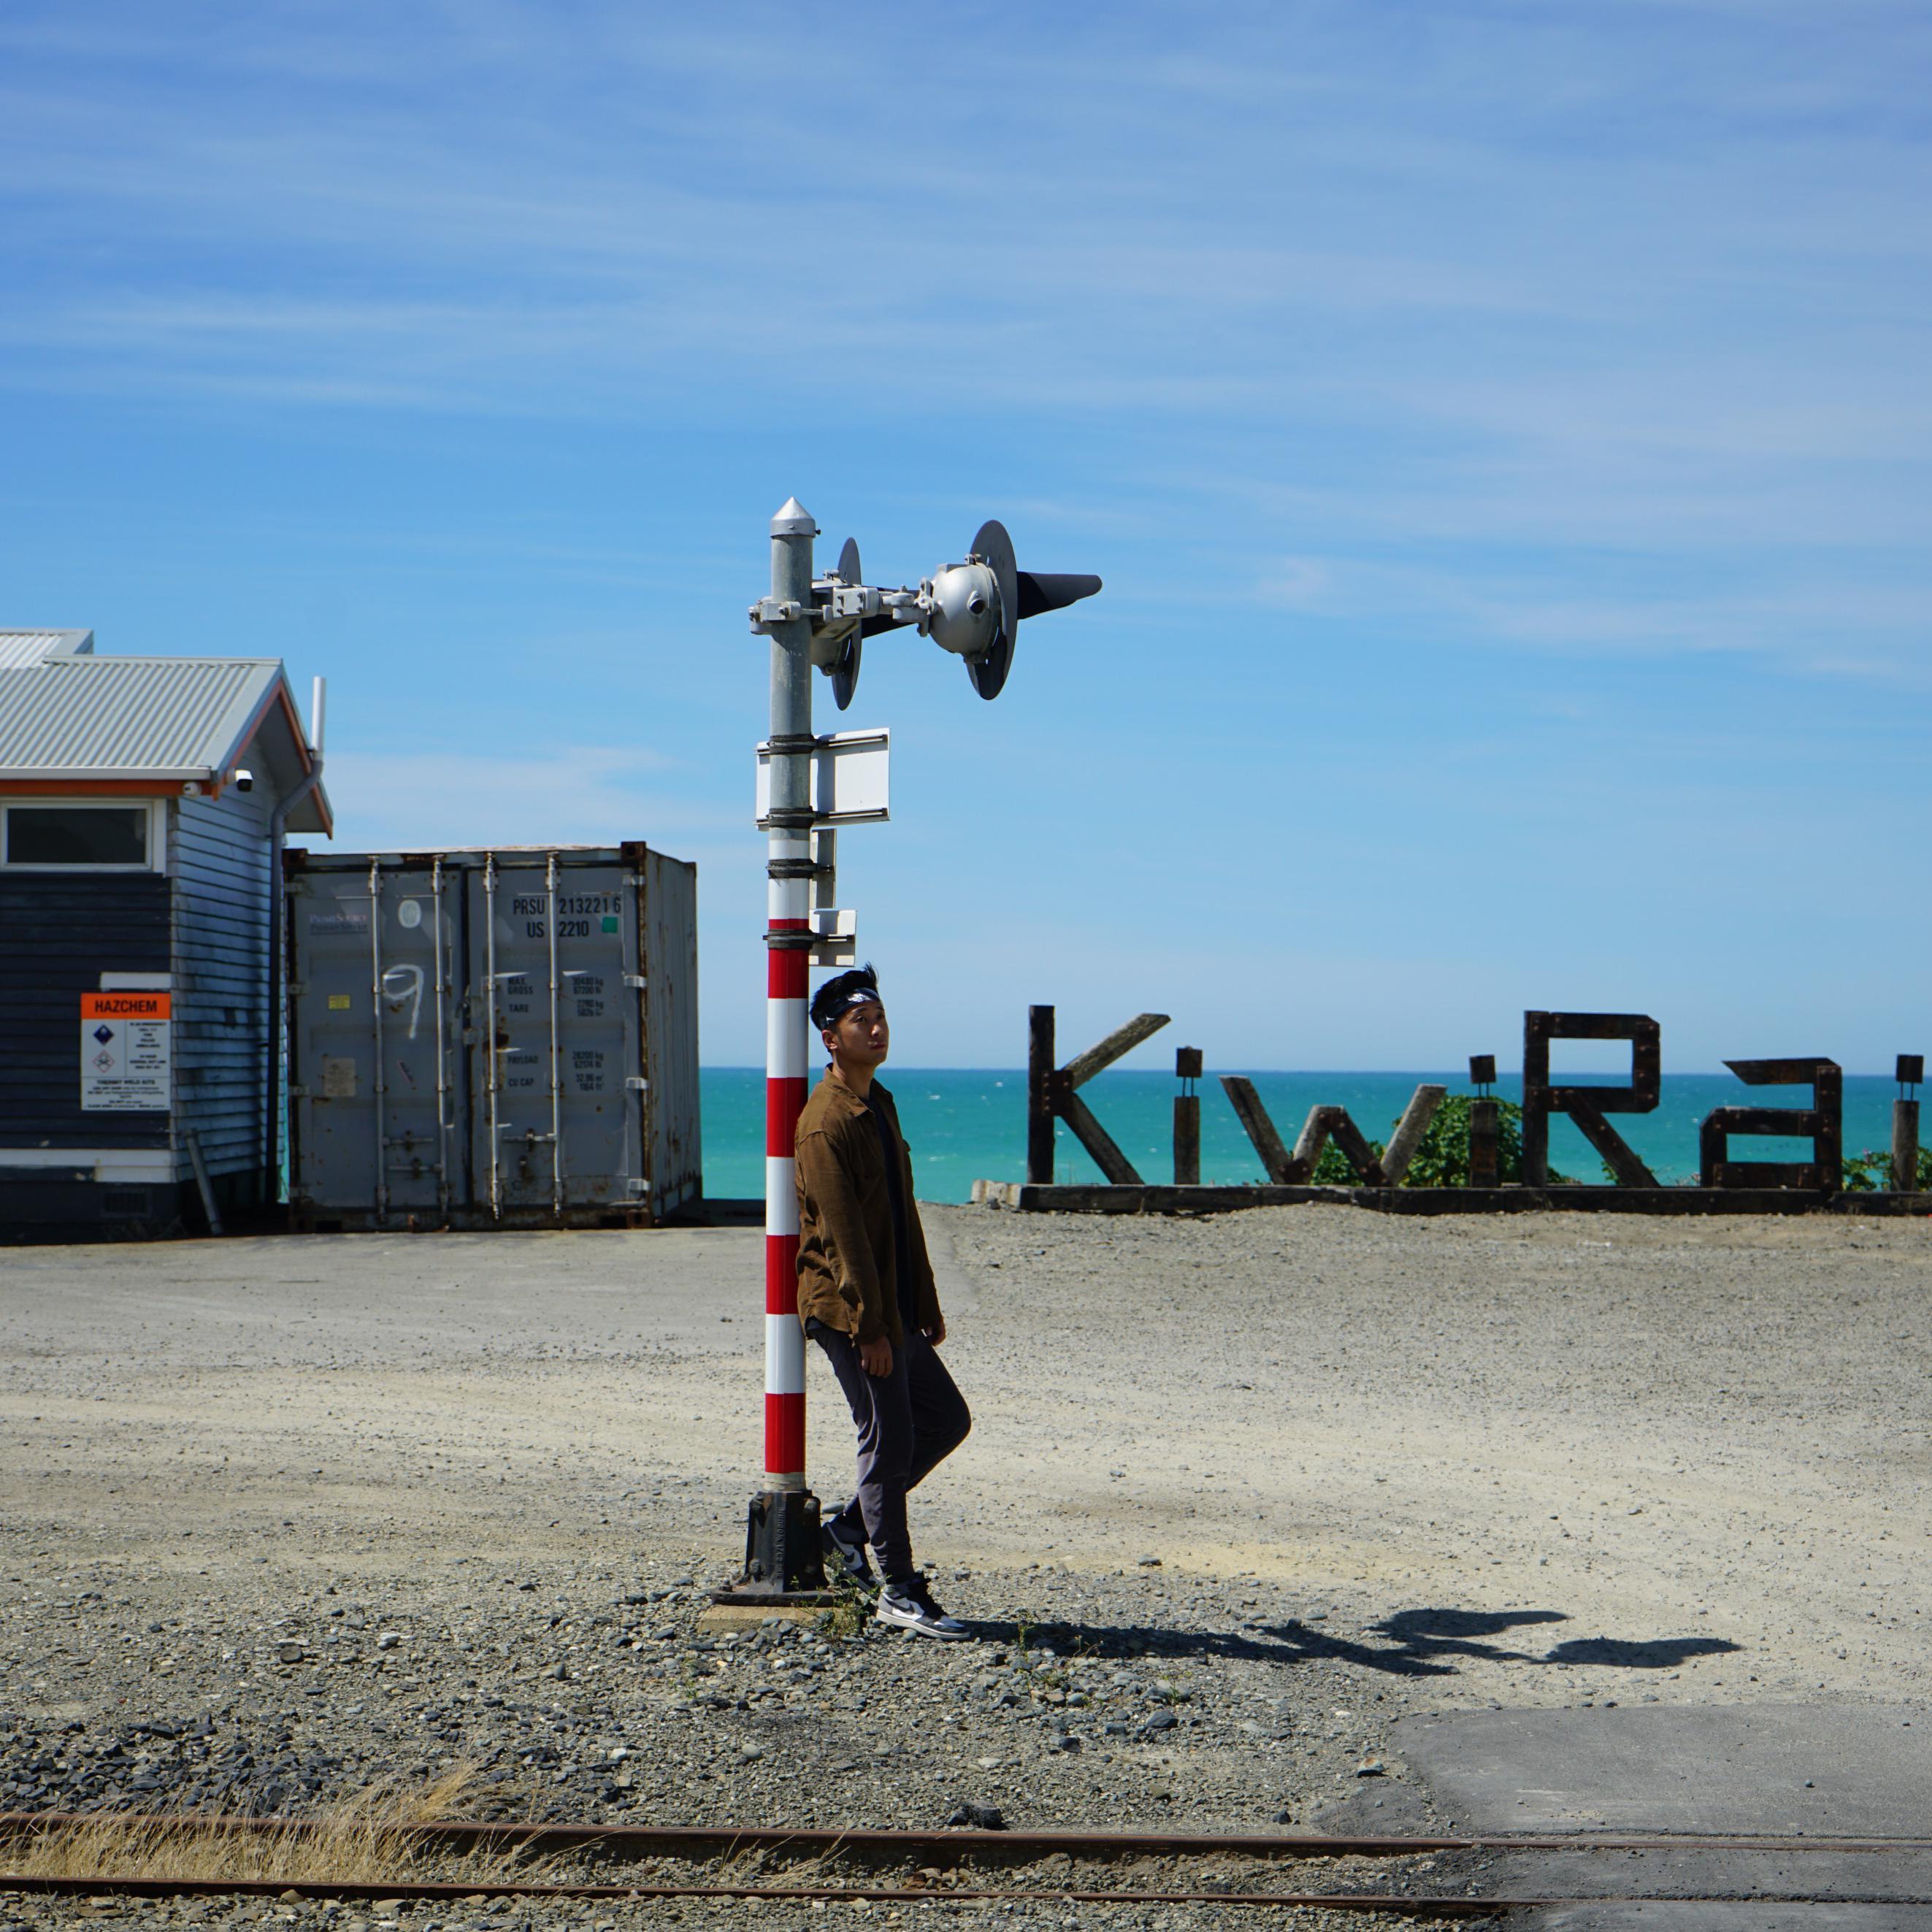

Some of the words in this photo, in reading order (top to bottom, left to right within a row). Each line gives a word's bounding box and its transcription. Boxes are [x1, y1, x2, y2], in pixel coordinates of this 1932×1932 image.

[513, 899, 545, 914] PRSU
[526, 921, 544, 938] US
[559, 921, 589, 937] 2210
[507, 986, 534, 994] GROSS
[94, 1000, 157, 1013] HAZCHEM
[383, 963, 424, 1040] 9
[509, 1004, 529, 1013] TARE
[507, 1055, 539, 1064] PAYLOAD
[508, 1078, 518, 1086] CU
[520, 1078, 534, 1086] CAP
